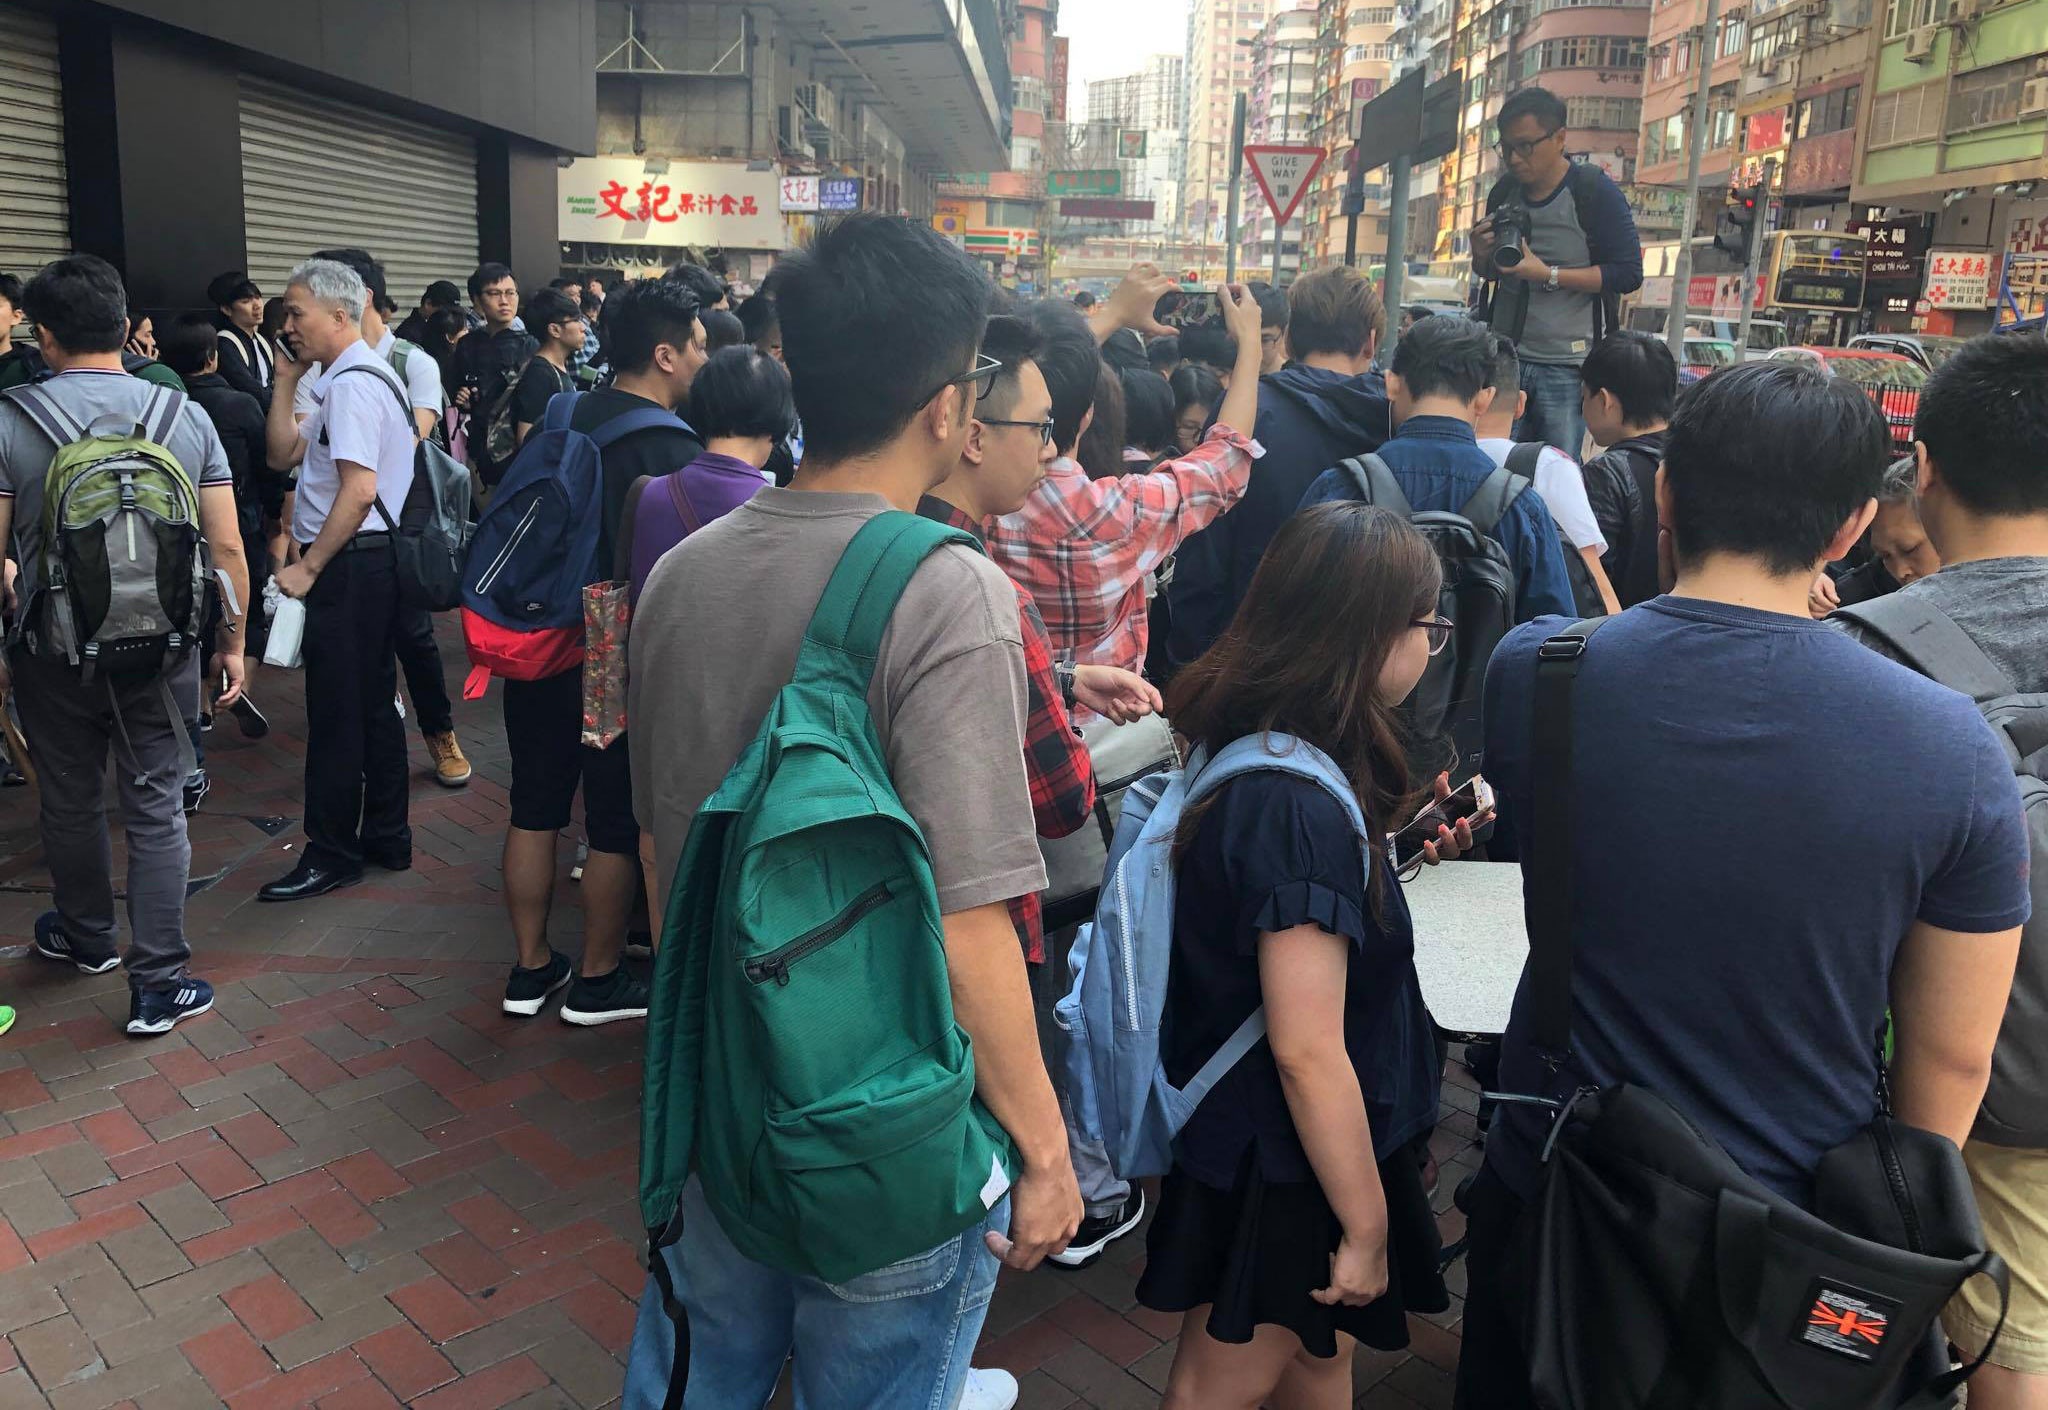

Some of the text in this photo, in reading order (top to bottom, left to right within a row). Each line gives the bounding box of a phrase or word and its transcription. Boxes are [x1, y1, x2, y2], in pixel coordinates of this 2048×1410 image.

[1271, 155, 1298, 167] GIVE
[1272, 168, 1297, 179] WAY
[1931, 257, 1988, 277] 正大藥房
